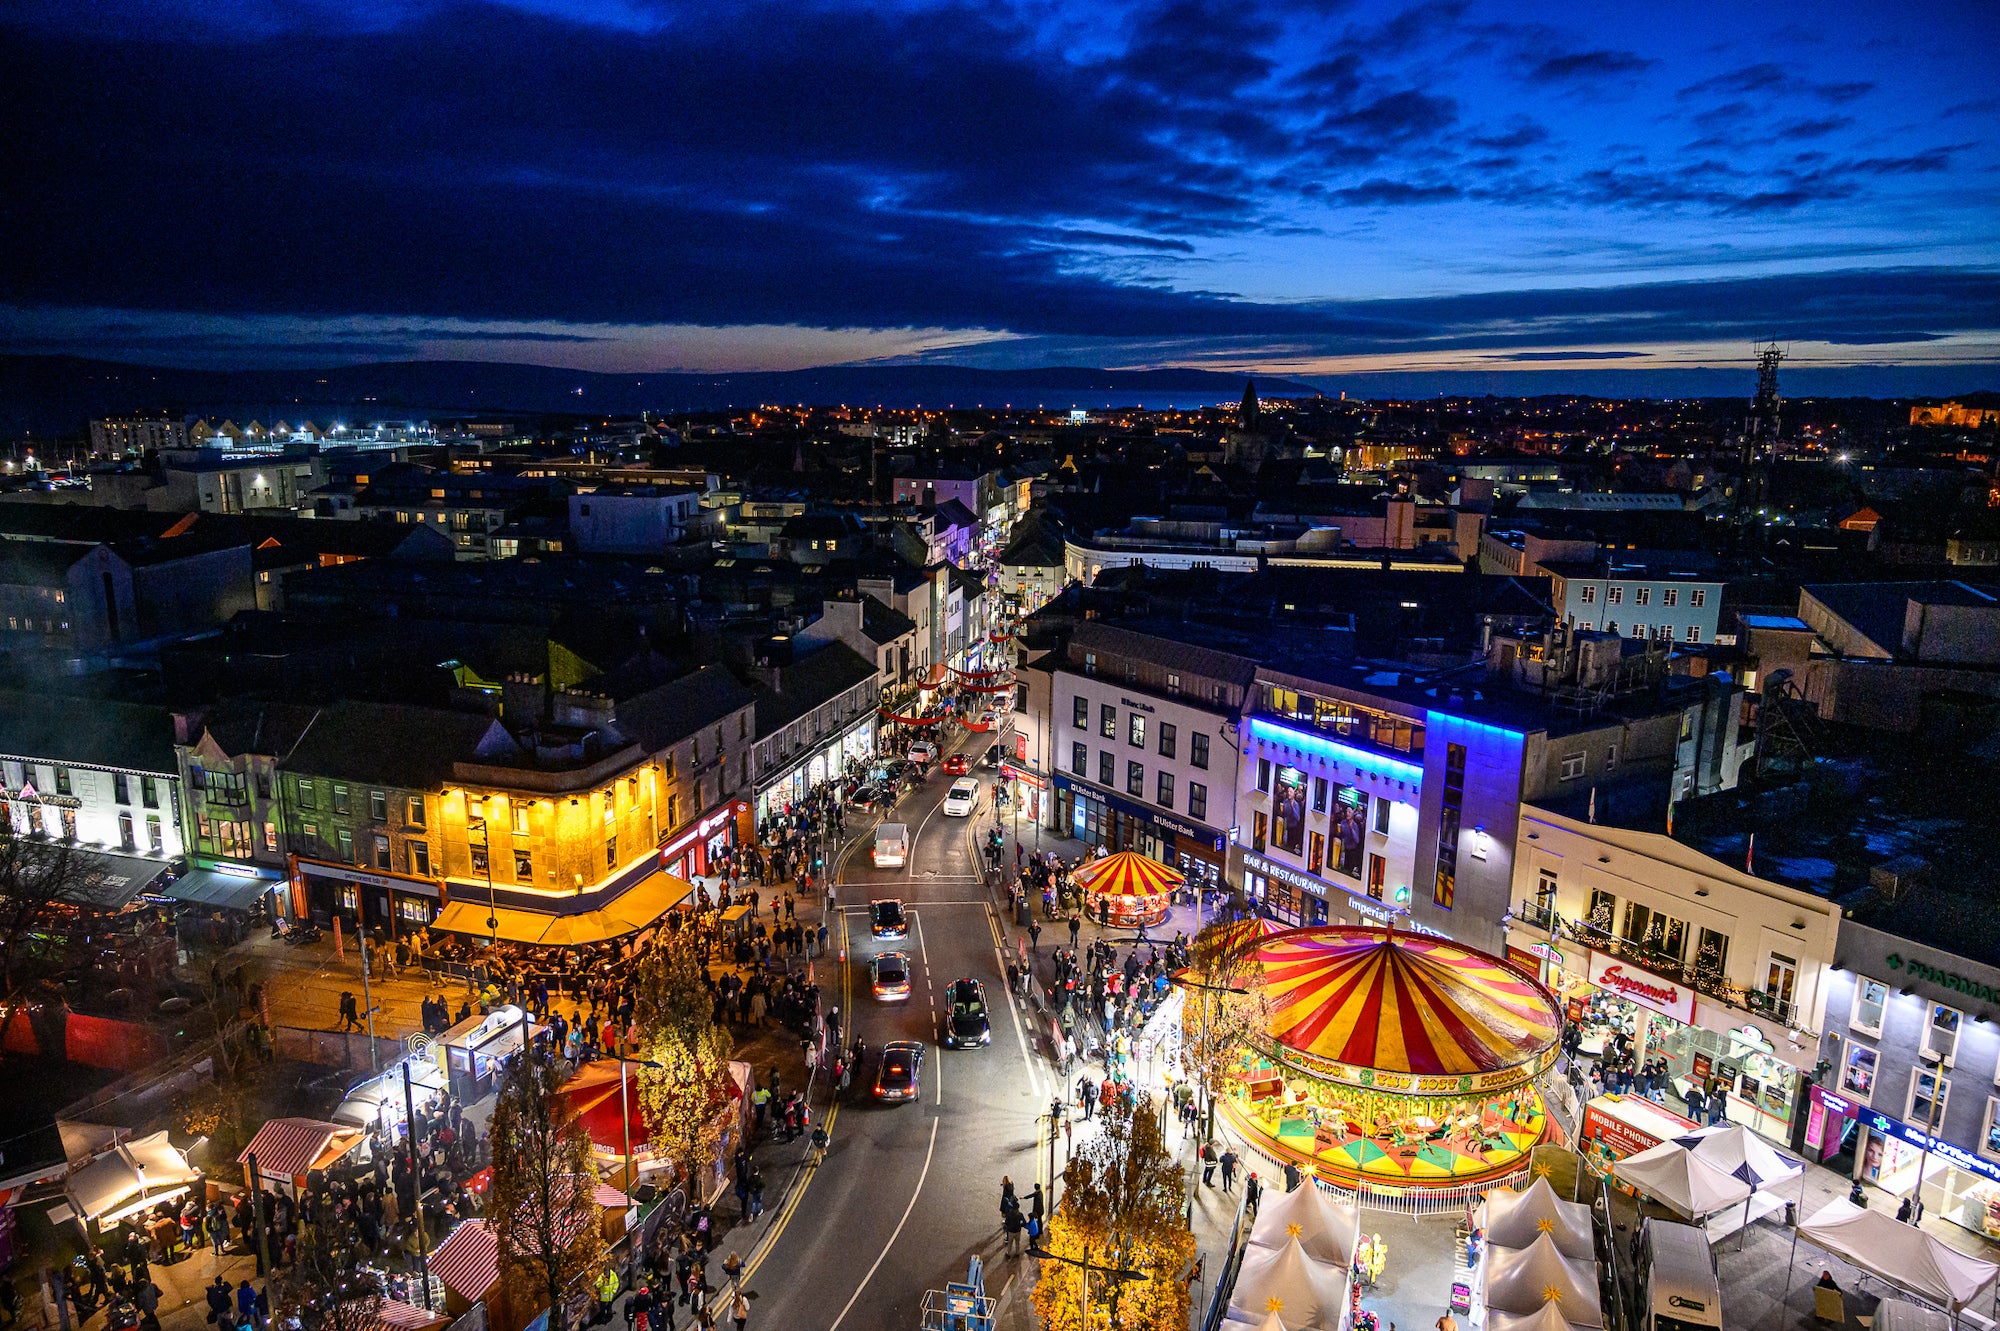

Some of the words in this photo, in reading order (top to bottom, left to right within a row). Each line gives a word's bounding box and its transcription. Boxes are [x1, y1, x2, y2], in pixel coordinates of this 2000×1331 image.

[1354, 766, 1419, 795] HOTEL
[1075, 784, 1092, 799] Ulster
[1092, 790, 1106, 804] Bank
[1159, 816, 1178, 832] Ulster
[1178, 824, 1195, 838] Bank
[1243, 853, 1261, 869] BAR
[1261, 861, 1269, 873] &
[1269, 864, 1327, 896] RESTAURANT
[1348, 896, 1389, 922] Imperial
[1599, 965, 1678, 1004] Supermac's
[1590, 1111, 1622, 1134] MOBILE
[592, 1143, 616, 1155] URGER
